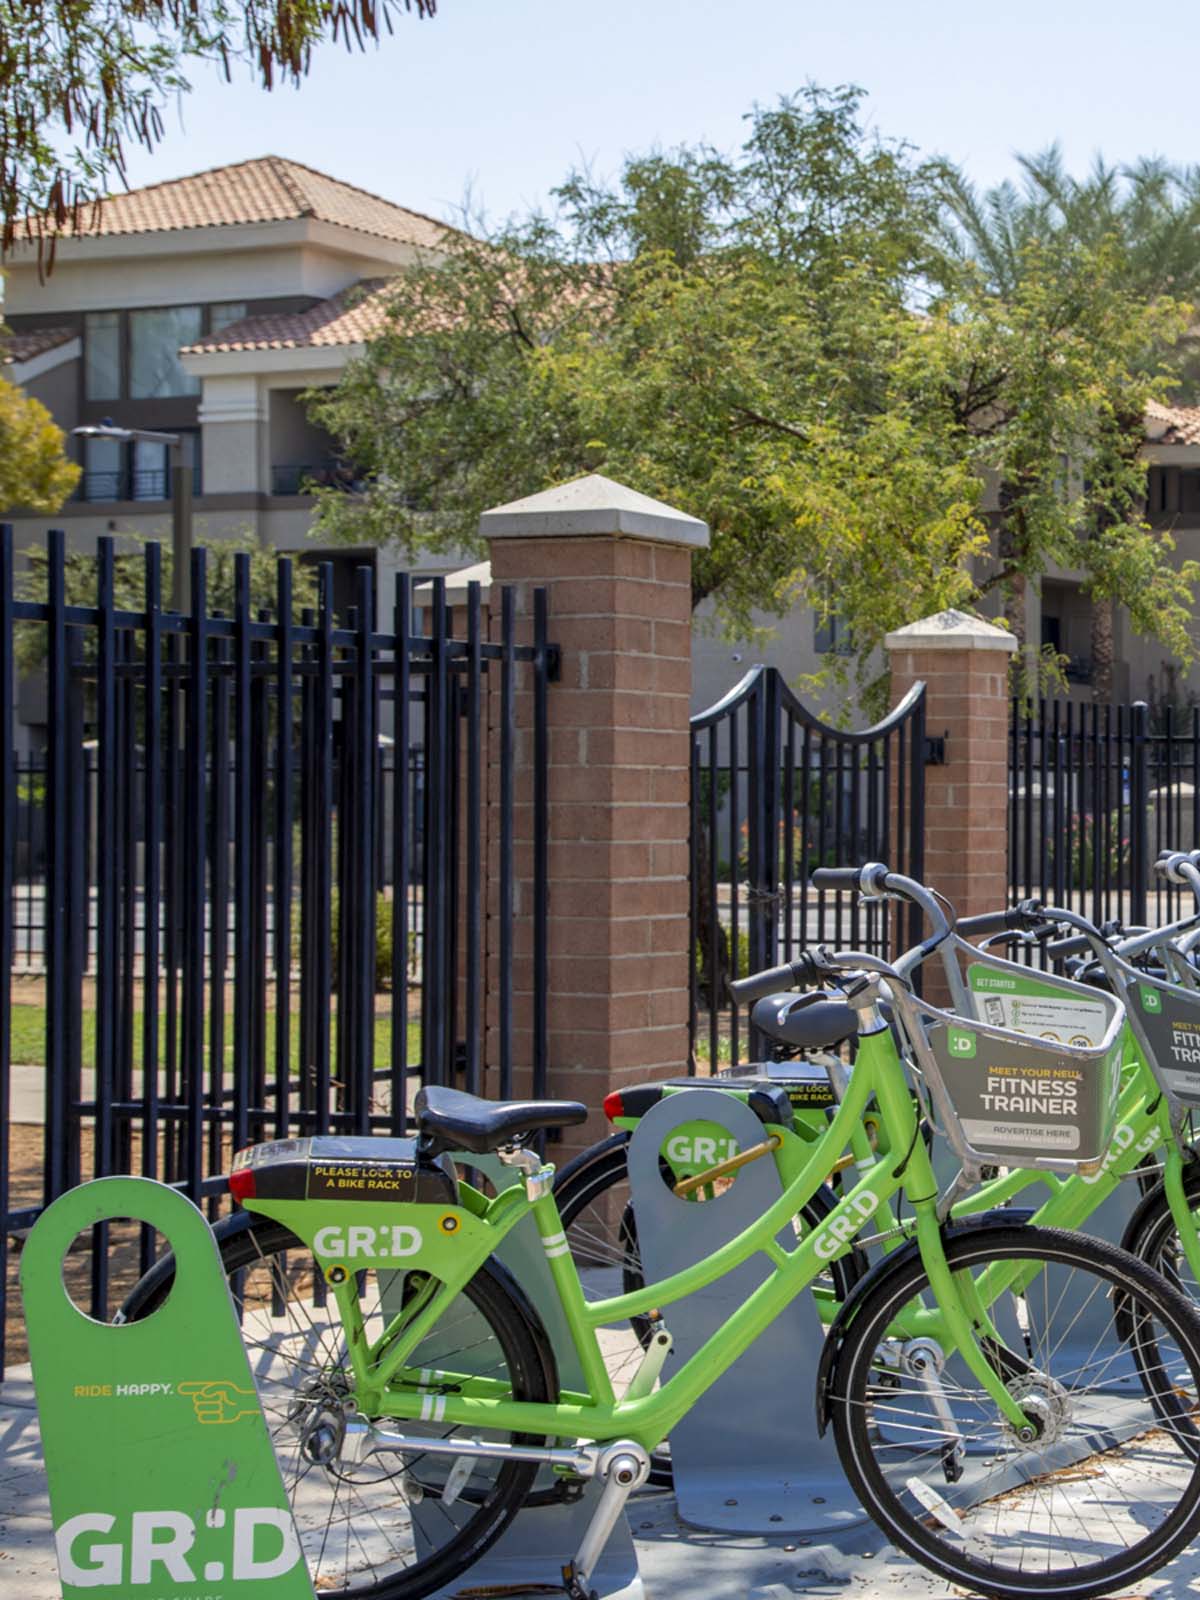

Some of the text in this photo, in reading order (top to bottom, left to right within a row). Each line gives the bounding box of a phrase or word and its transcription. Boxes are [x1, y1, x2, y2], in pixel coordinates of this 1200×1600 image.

[976, 978, 990, 988] GET
[1172, 1022, 1191, 1031] MEET
[989, 1066, 1080, 1079] MEET YOUR NEW
[806, 1085, 829, 1093] LOCK
[987, 1076, 1078, 1097] FITNESS
[979, 1093, 1078, 1116] TRAINER
[993, 1125, 1071, 1138] ADVERTISE HERE
[314, 1166, 413, 1180] PLEASE LOCK TO
[326, 1178, 401, 1190] A BIKE RACK
[74, 1383, 175, 1398] RIDE HAPPY.
